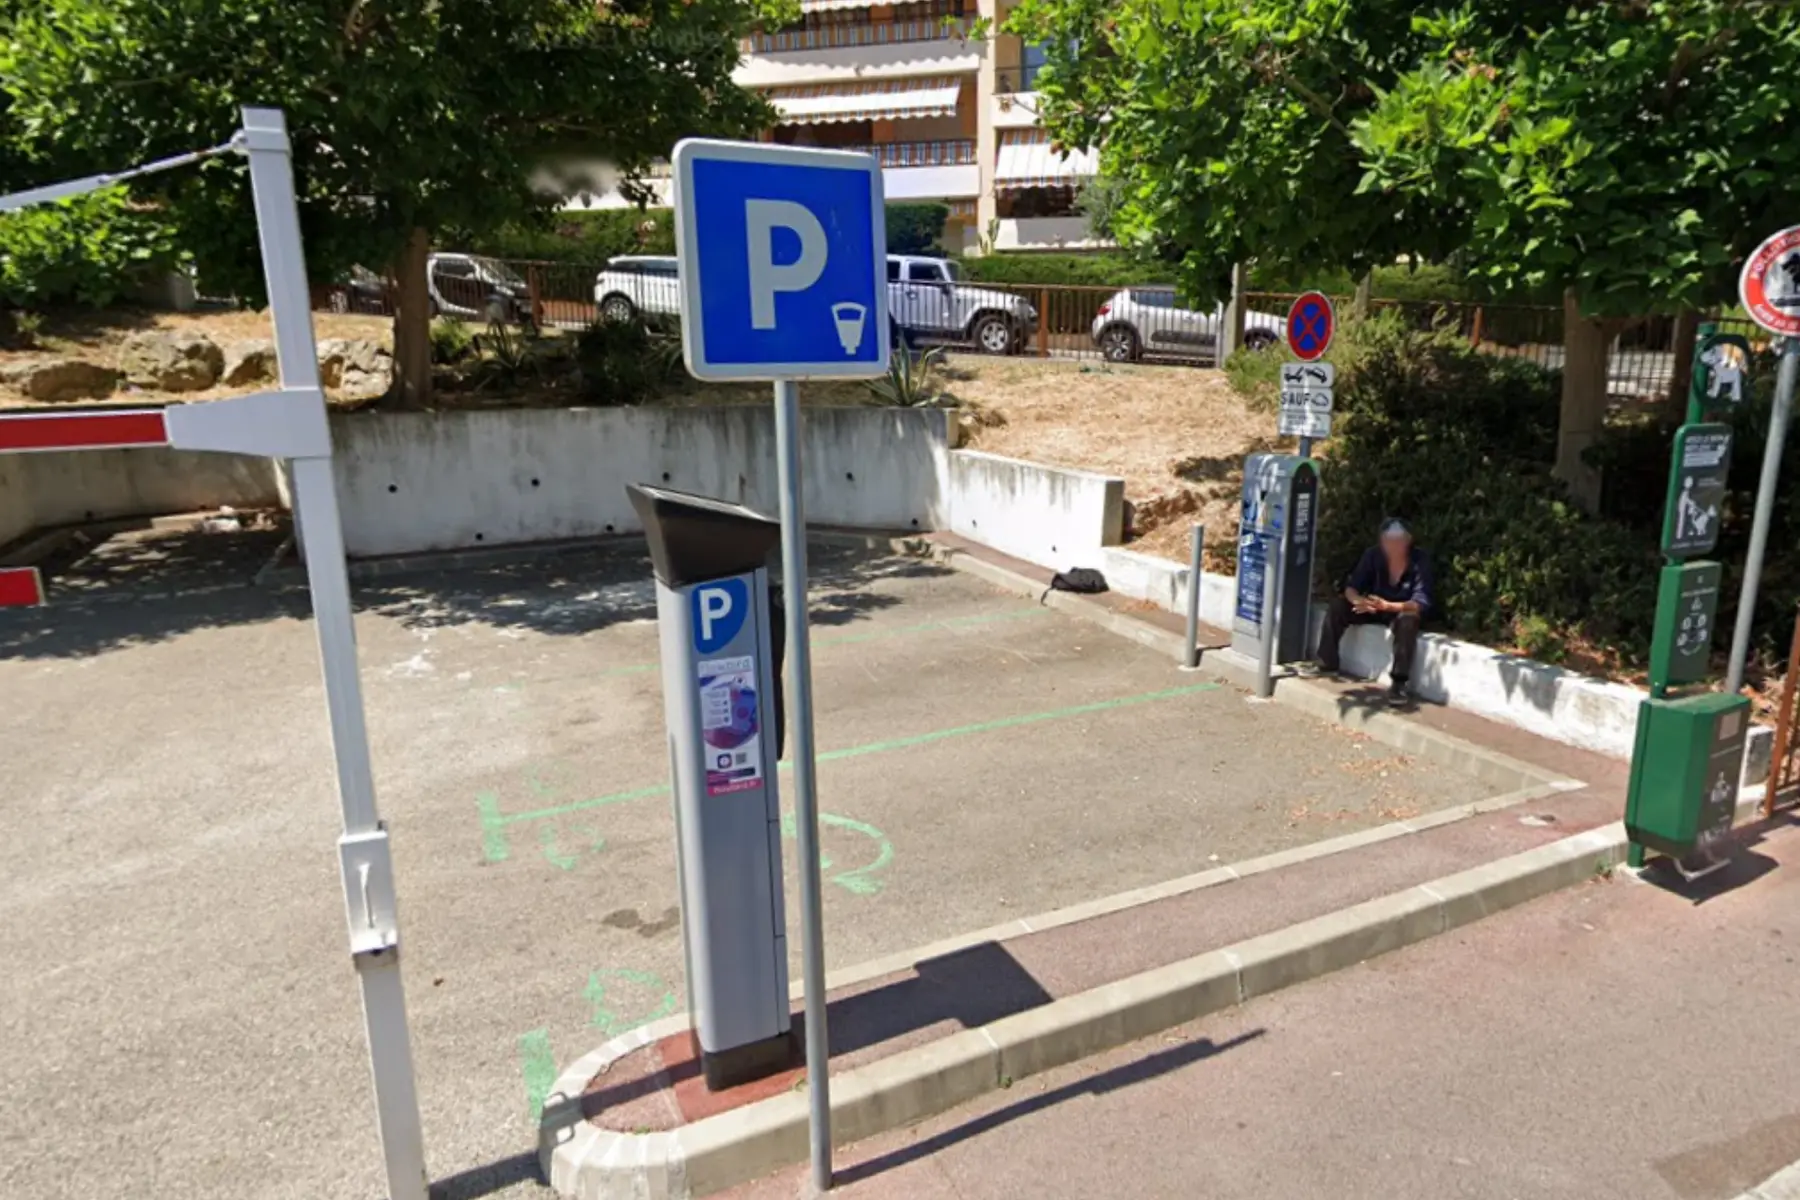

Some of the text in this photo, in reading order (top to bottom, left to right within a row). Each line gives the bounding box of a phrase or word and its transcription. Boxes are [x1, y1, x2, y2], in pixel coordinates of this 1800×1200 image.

[745, 198, 828, 330] P
[1281, 392, 1310, 406] SAUF
[700, 588, 732, 640] P
